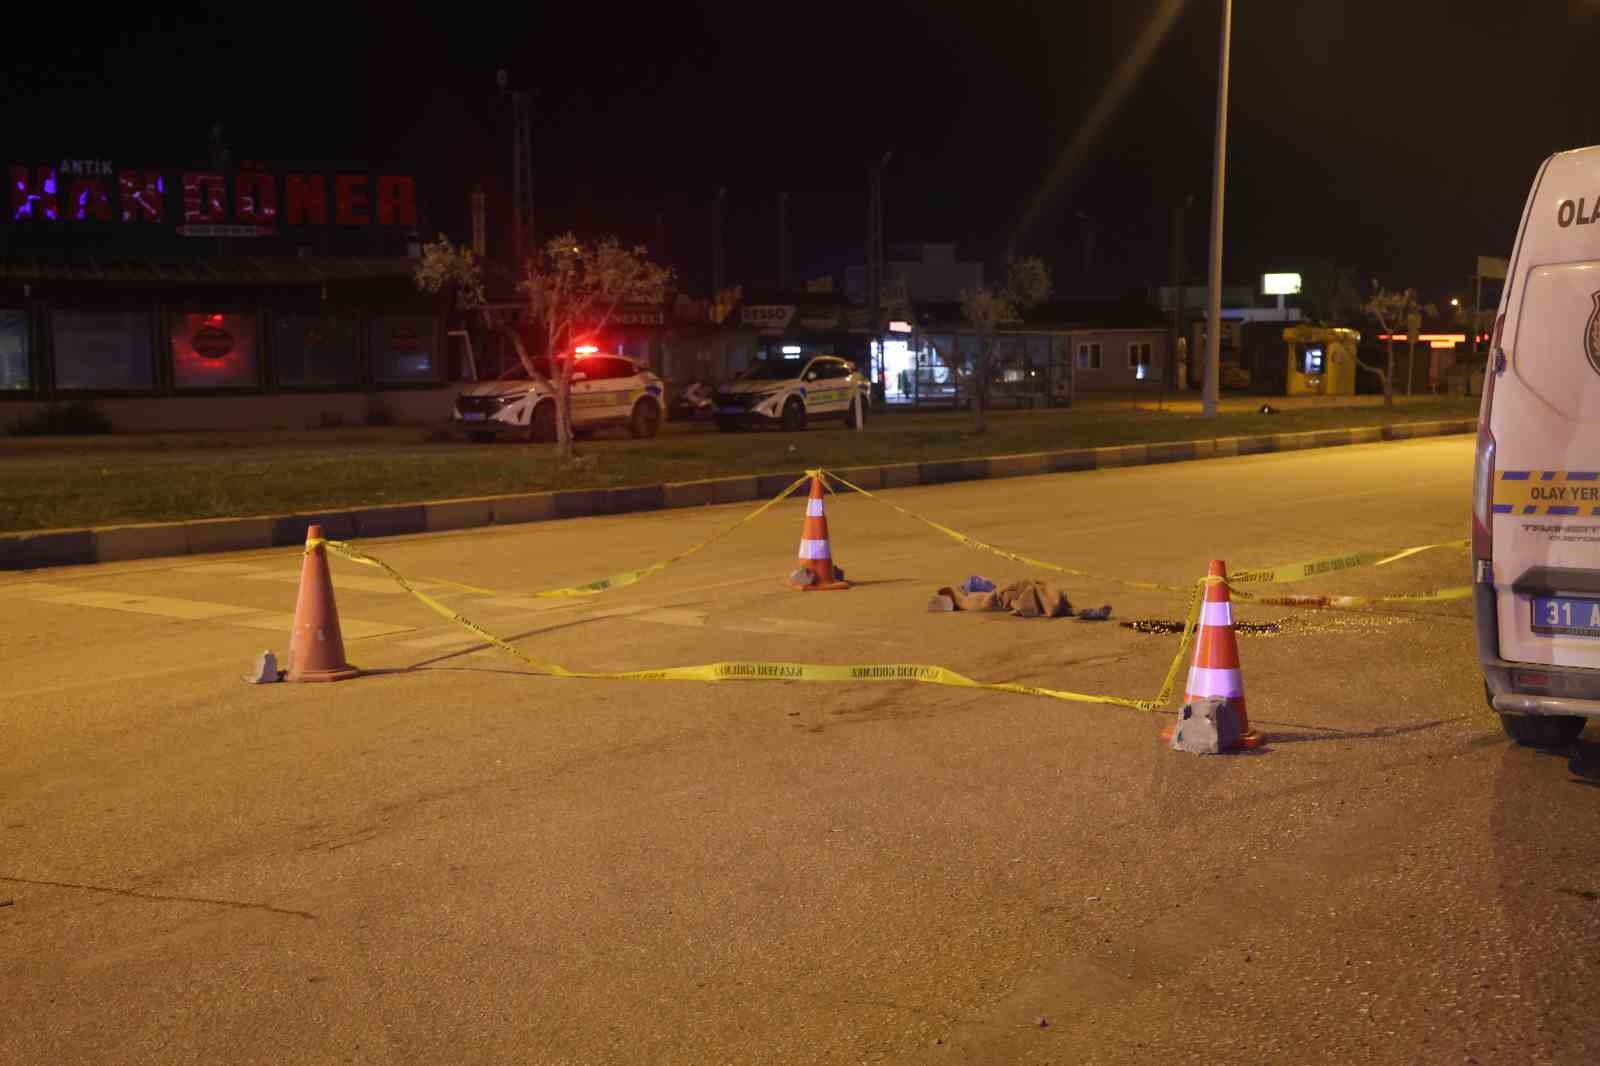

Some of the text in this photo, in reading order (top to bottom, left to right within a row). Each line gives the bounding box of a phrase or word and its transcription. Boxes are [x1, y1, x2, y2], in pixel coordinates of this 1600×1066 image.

[61, 158, 112, 175] ANTİK
[1531, 487, 1566, 500] OLAY
[1546, 601, 1571, 626] 31
